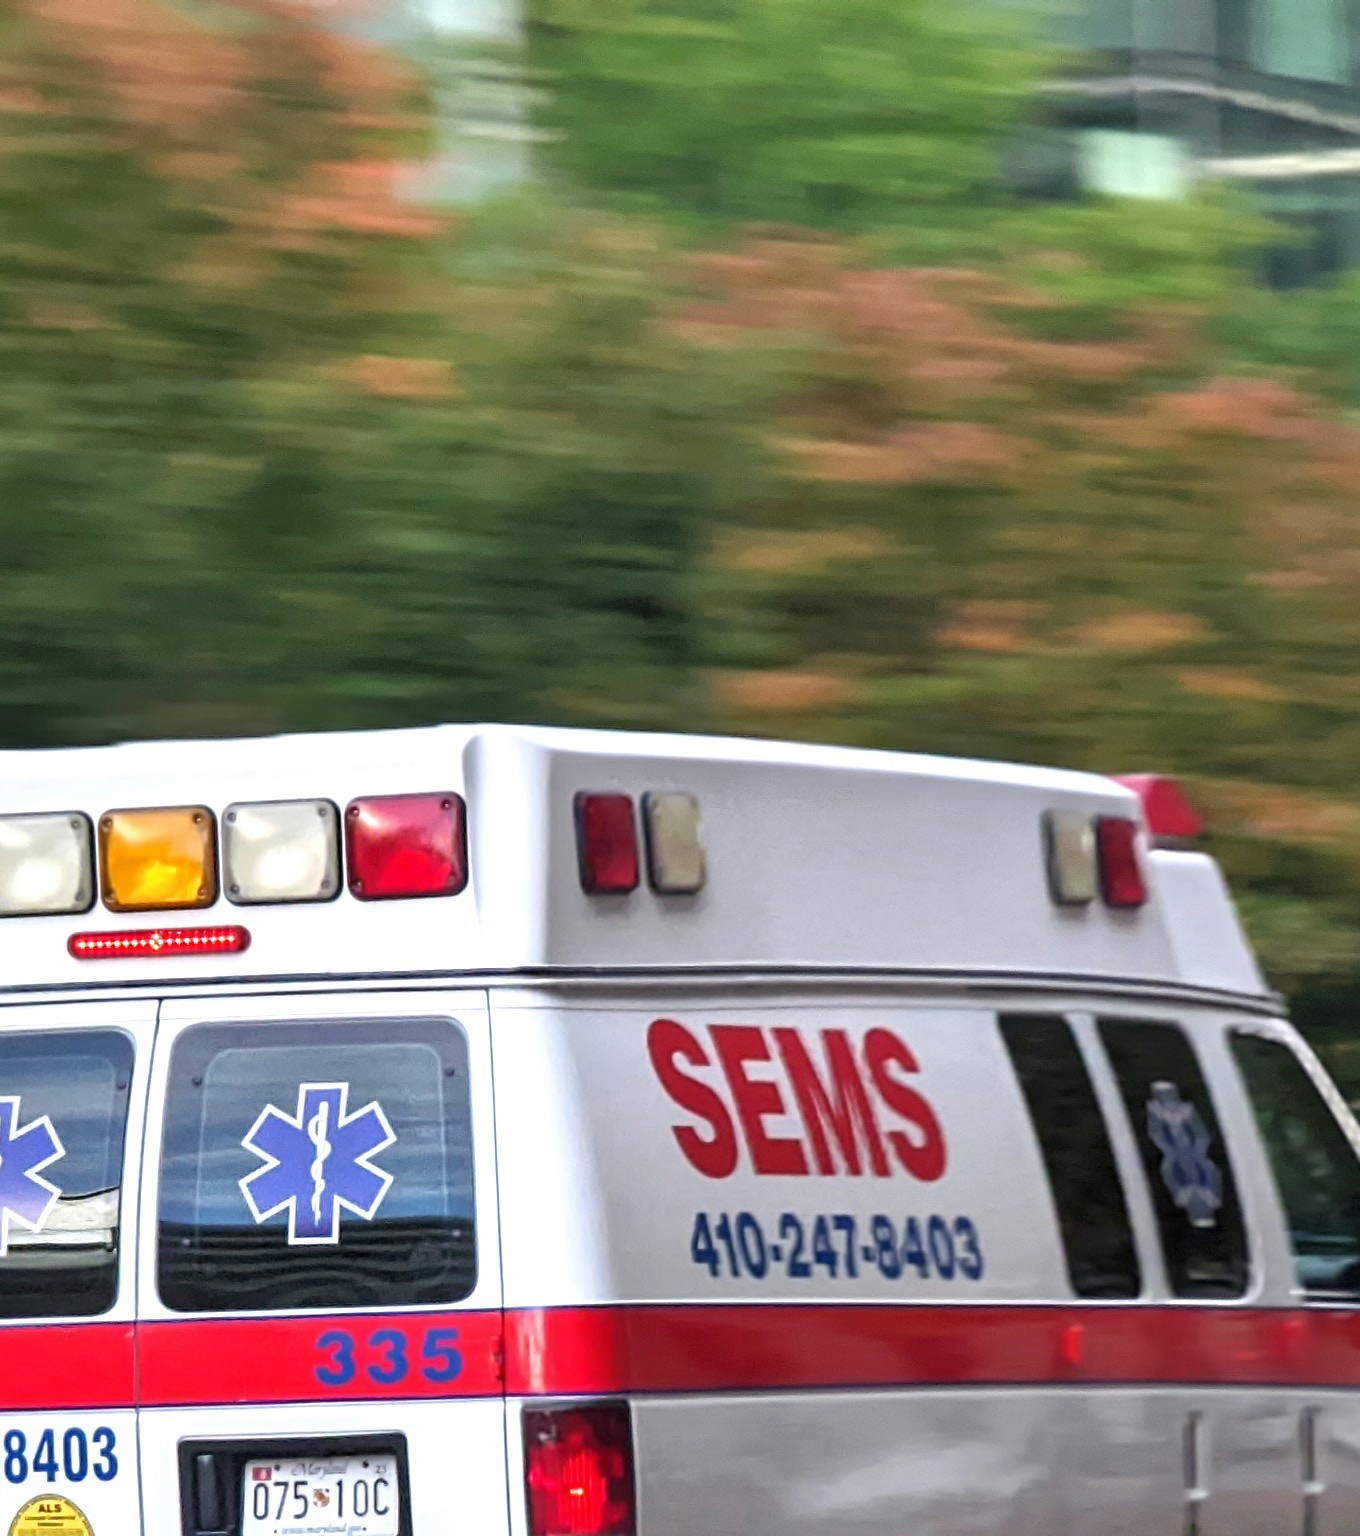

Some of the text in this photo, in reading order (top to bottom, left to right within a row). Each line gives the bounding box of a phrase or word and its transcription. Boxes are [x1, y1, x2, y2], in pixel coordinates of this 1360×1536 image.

[647, 1018, 947, 1181] SEMS
[691, 1212, 984, 1280] 410-247-8403
[315, 1329, 463, 1386] 335
[38, 1504, 62, 1513] ALS
[253, 1483, 308, 1520] 075
